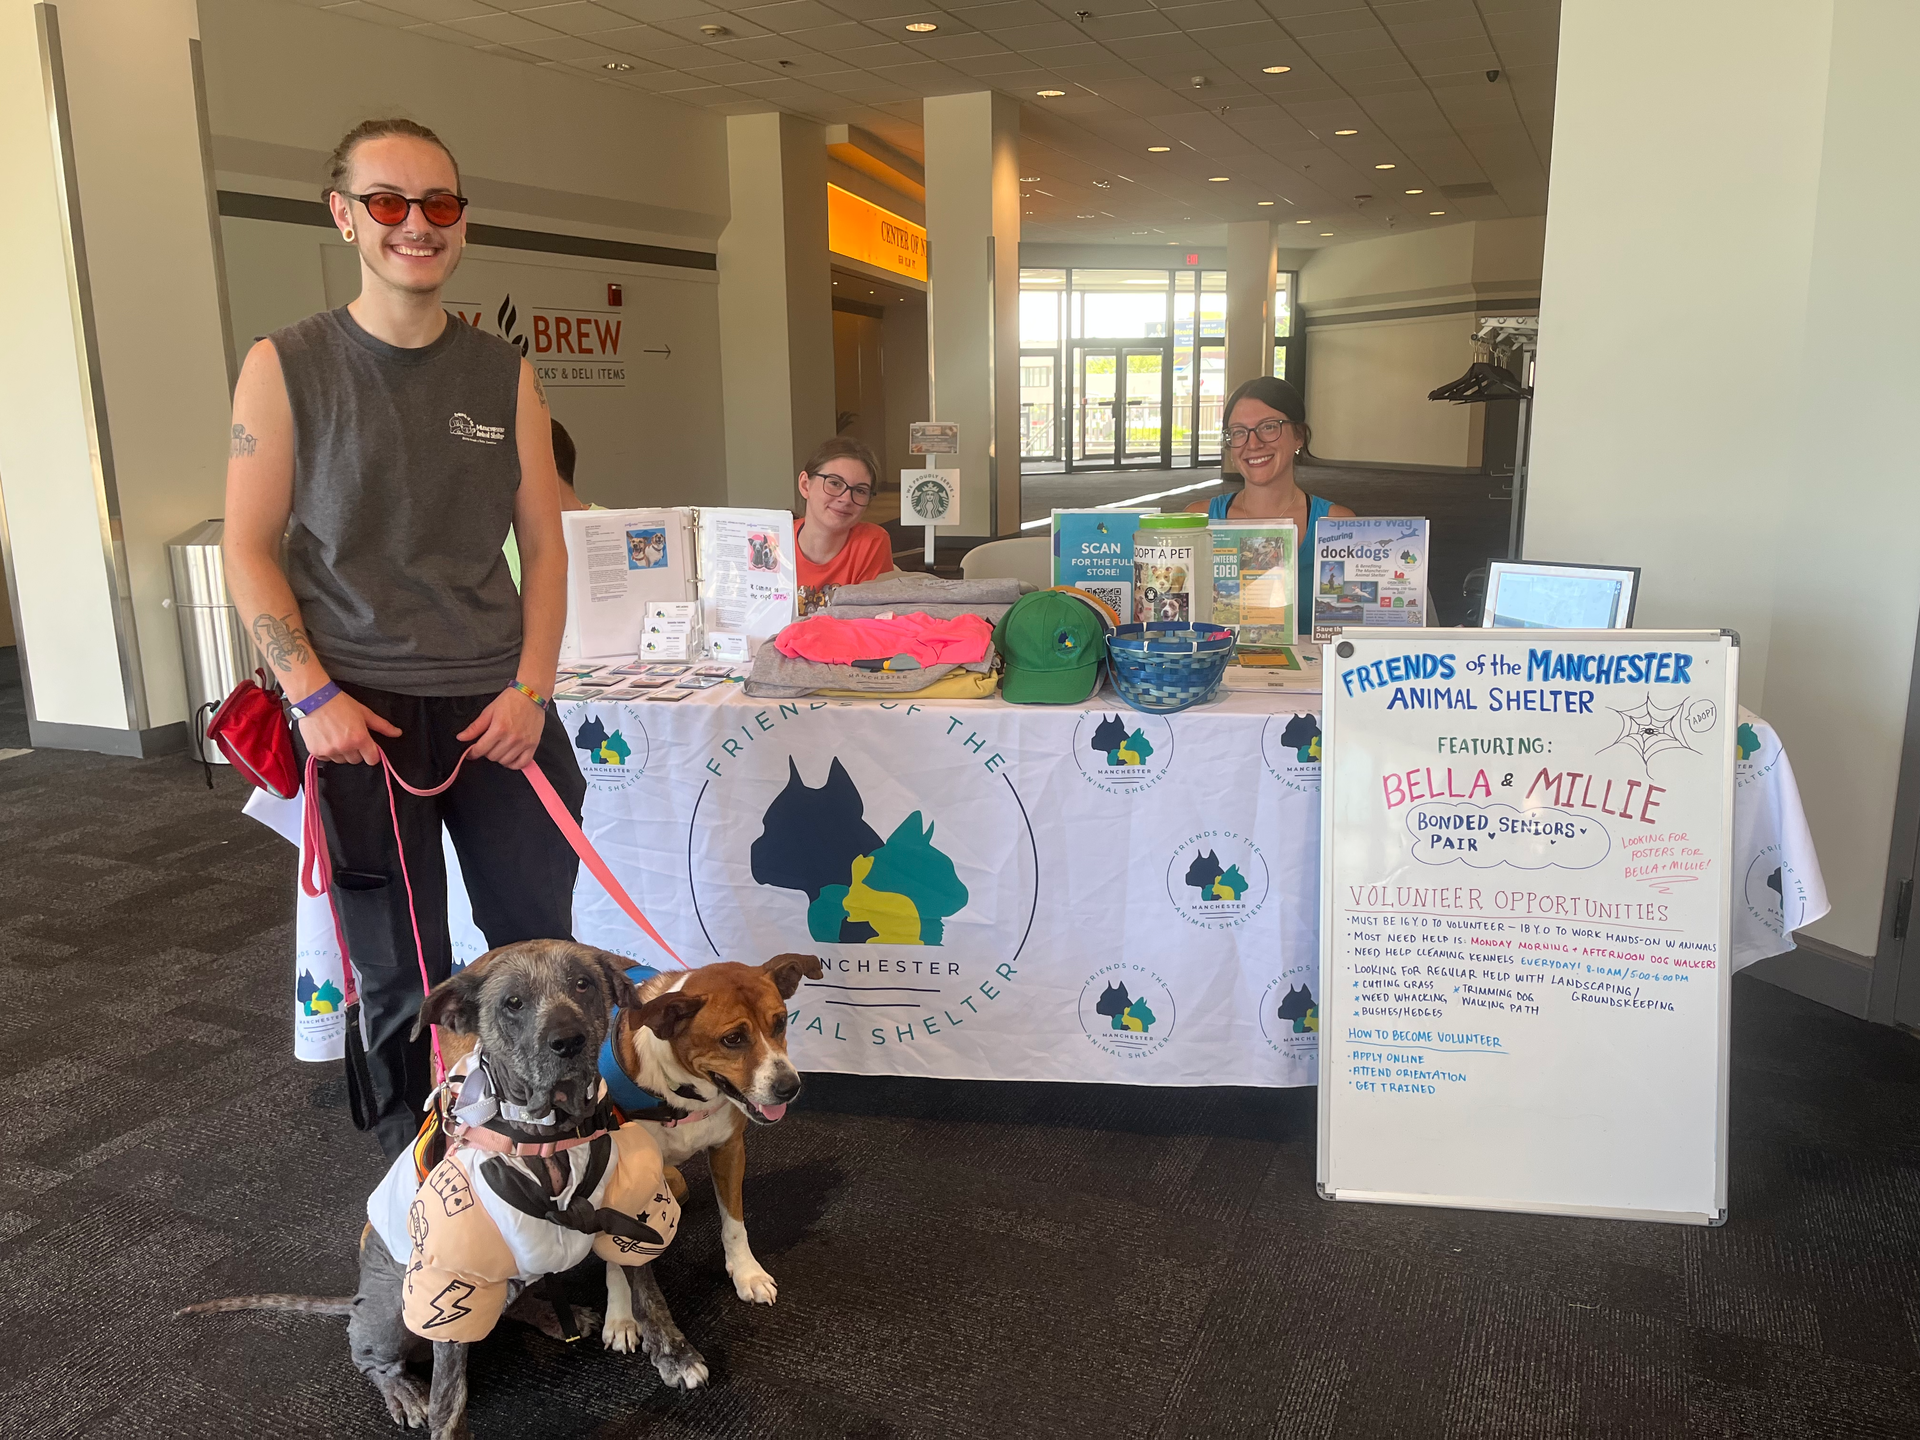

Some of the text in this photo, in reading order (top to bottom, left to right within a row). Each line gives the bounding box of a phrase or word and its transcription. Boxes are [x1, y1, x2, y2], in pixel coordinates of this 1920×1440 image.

[881, 220, 909, 250] CENTER
[911, 234, 919, 254] OF
[1186, 254, 1198, 265] EXIT
[532, 315, 621, 355] BREW
[561, 368, 568, 379] &
[572, 368, 594, 379] DELI
[598, 368, 625, 380] ITEMS
[906, 474, 954, 494] WE PROUDLY SERVE
[1318, 532, 1353, 544] Featuring
[1081, 543, 1121, 554] SCAN
[1135, 547, 1191, 559] DOPT A PET
[1321, 545, 1390, 561] dockdogs
[1071, 558, 1134, 566] FOR THE FULL
[1213, 555, 1238, 563] UNTEERS
[1086, 568, 1120, 576] STORE!
[1213, 565, 1238, 578] EDED
[1341, 652, 1457, 698] FRIENDS
[1466, 654, 1487, 677] of
[1490, 655, 1522, 677] the
[1526, 648, 1693, 685] MANCHESTER
[1386, 687, 1595, 714] ANIMAL SHELTER
[623, 704, 640, 721] THE
[1692, 706, 1715, 726] ADOPT
[946, 715, 1006, 774] THE
[1438, 737, 1553, 756] FEATURING:
[608, 769, 645, 792] SHELTER
[1081, 768, 1167, 795] ANIMAL SHELTER
[1269, 768, 1307, 792] ANIMAL
[1737, 765, 1772, 787] ELTER
[1382, 767, 1667, 825] BELLA & MILLIE
[1417, 812, 1575, 838] BONDED SENIORS
[1174, 830, 1261, 856] FRIENDS OF THE
[1430, 834, 1479, 852] PAIR
[1621, 832, 1690, 849] LOOKING FOR
[1631, 847, 1704, 861] FOSTERS FOR
[1625, 863, 1659, 879] BELLA
[1669, 859, 1712, 871] MILLIE!
[1783, 861, 1795, 874] OF
[1795, 879, 1807, 902] THE
[1349, 885, 1669, 921] VOLUNTEER OPPORTUNITIES
[1174, 903, 1262, 930] ANIMAL SHELTER
[1351, 915, 1378, 926] MUST
[1383, 916, 1396, 926] BE
[1400, 917, 1410, 926] 16
[1432, 918, 1442, 928] TO
[1446, 920, 1505, 932] VOLUNTEER
[1520, 924, 1530, 933] 18
[1556, 926, 1567, 936] TO
[1571, 928, 1602, 939] WORK
[1606, 932, 1661, 946] HANDS-ON
[1678, 941, 1717, 953] ANIMALS
[1354, 932, 1381, 942] MOST
[1387, 933, 1417, 943] NEED
[1422, 933, 1449, 943] HELP
[1470, 937, 1512, 949] MONDAY
[1518, 941, 1569, 953] MORNING
[1582, 947, 1645, 962] AFTERNOON
[1650, 955, 1669, 965] DOG
[1673, 959, 1716, 969] WALKERS
[1354, 947, 1381, 958] NEED
[1386, 948, 1412, 957] HELP
[1416, 947, 1465, 961] CLEANING
[1469, 953, 1514, 964] KENNELS
[819, 957, 960, 976] NCHESTER
[1084, 963, 1168, 989] FRIENDS OF THE
[1354, 964, 1397, 976] LOOKING
[1401, 966, 1421, 976] FOR
[1427, 966, 1478, 980] REGULAR
[1483, 970, 1510, 981] HELP
[1515, 974, 1545, 984] WITH
[1266, 964, 1311, 990] FRIENDS
[1362, 980, 1434, 989] CUTTING GRASS
[1361, 993, 1389, 1002] WEED
[1462, 984, 1534, 1001] TRIMMING DOG
[1571, 991, 1675, 1012] GROUNDSKEEPING
[871, 962, 1018, 1045] SHELTER
[1362, 1007, 1443, 1019] BUSHES/HEDGES
[1462, 997, 1539, 1015] WALKING PATH
[322, 1027, 346, 1041] SHEL
[1102, 1033, 1154, 1041] MANCHESTER
[1348, 1028, 1502, 1047] HOW TO BECOME VOLUNTEER
[1086, 1034, 1169, 1058] ANIMAL SHELTER
[1266, 1039, 1303, 1060] ANIMAL
[1352, 1051, 1425, 1064] APPLY ONLINE
[1352, 1066, 1466, 1082] ATTEND ORIENTATION
[1355, 1081, 1435, 1094] GET TRAINED
